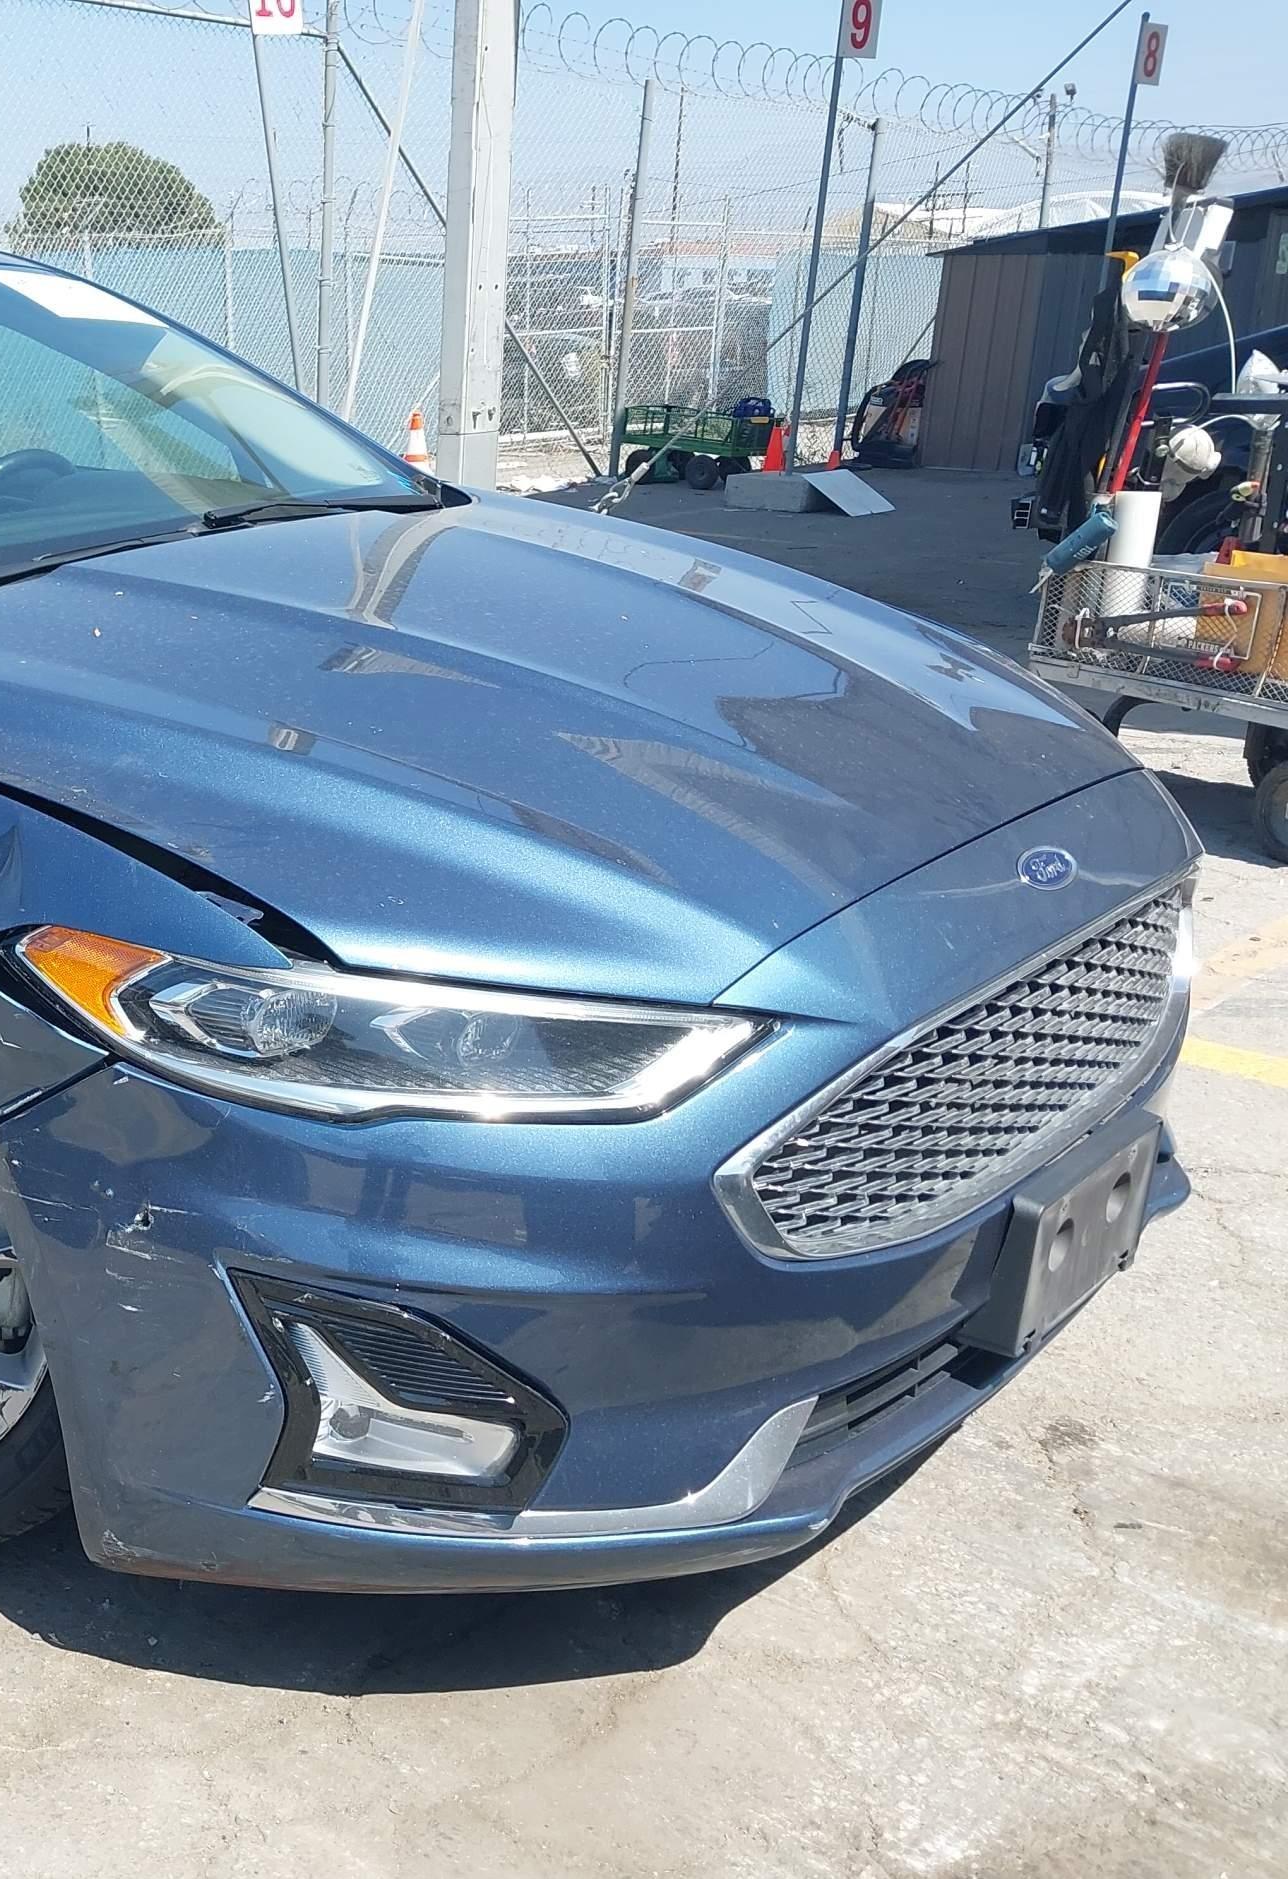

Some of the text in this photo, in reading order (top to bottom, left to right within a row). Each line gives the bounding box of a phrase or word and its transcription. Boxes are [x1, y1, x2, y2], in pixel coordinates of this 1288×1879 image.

[850, 0, 872, 49] 9
[1143, 31, 1160, 77] 8
[1030, 854, 1066, 882] Ford
